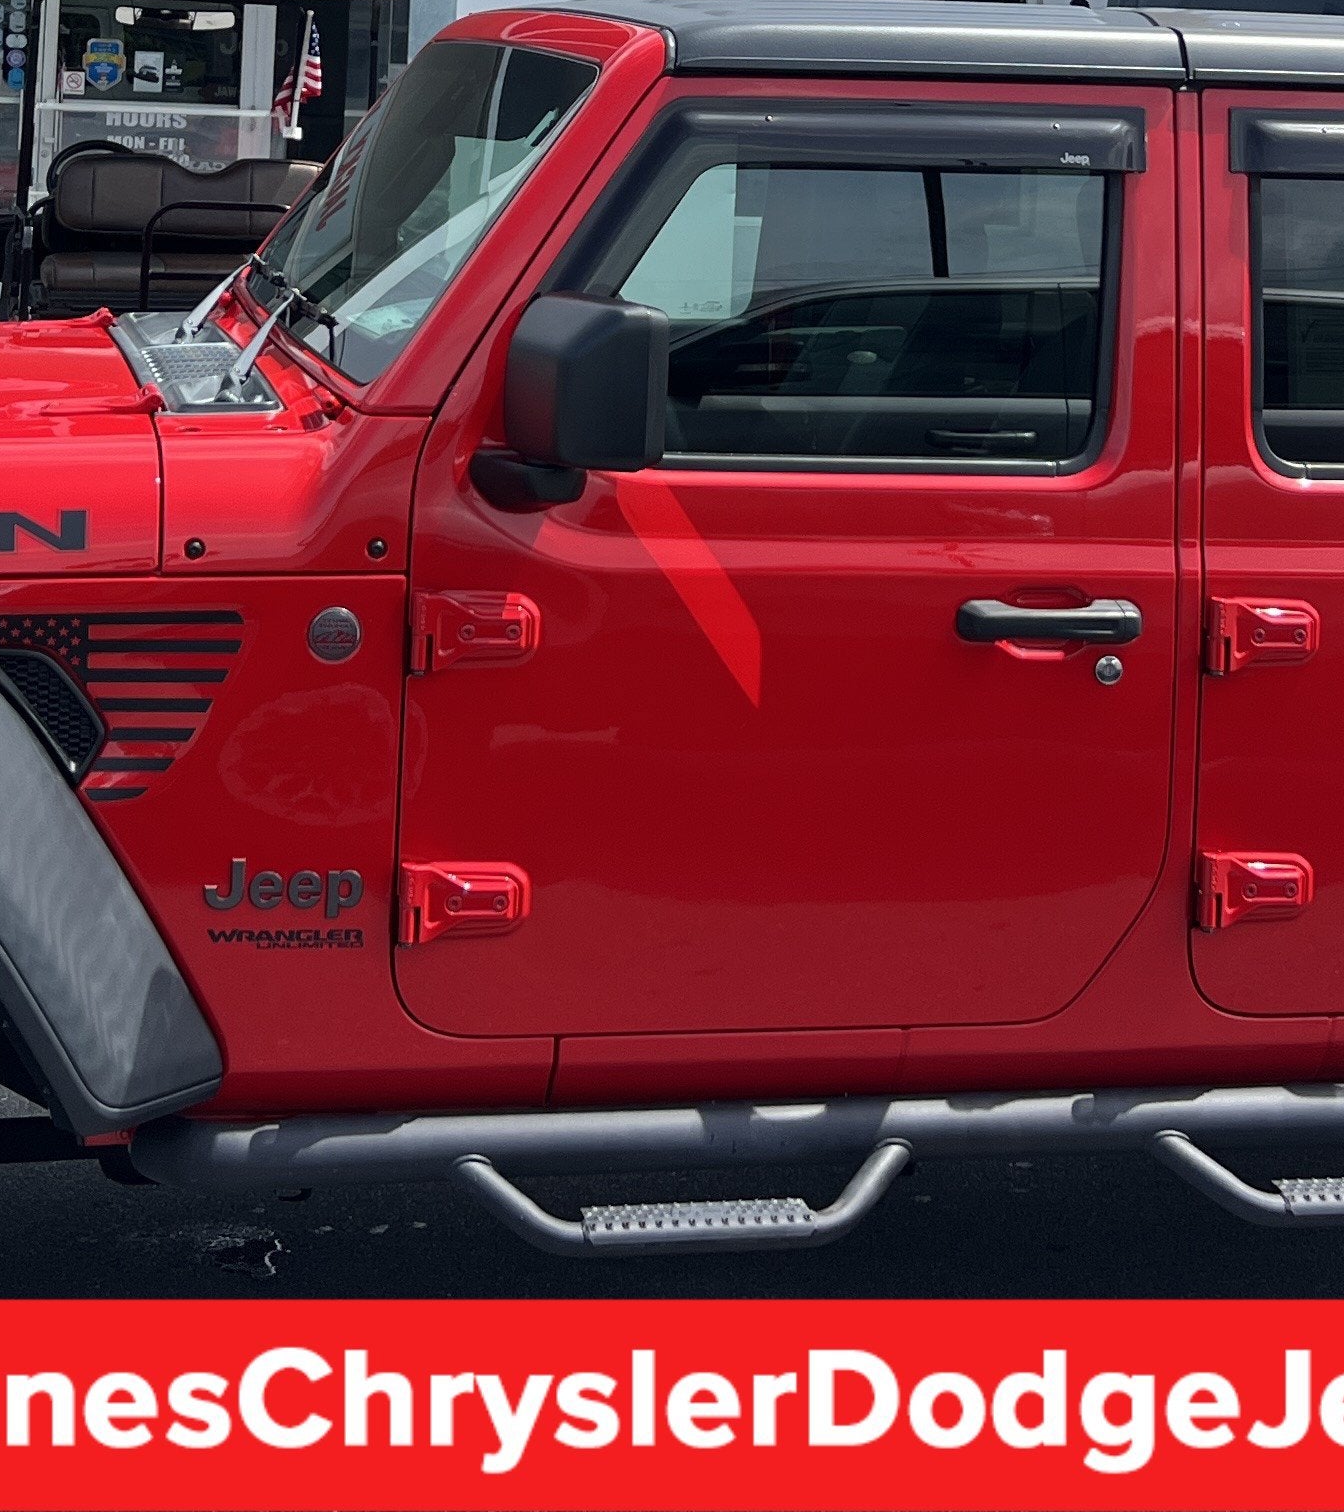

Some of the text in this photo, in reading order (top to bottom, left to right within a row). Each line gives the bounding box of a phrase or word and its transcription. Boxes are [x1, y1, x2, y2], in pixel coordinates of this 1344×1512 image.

[105, 111, 188, 129] HOURS
[1059, 152, 1091, 167] Jeep
[203, 856, 365, 920] Jeep
[208, 928, 364, 944] WRANGLER
[256, 939, 364, 950] UNLIMITED
